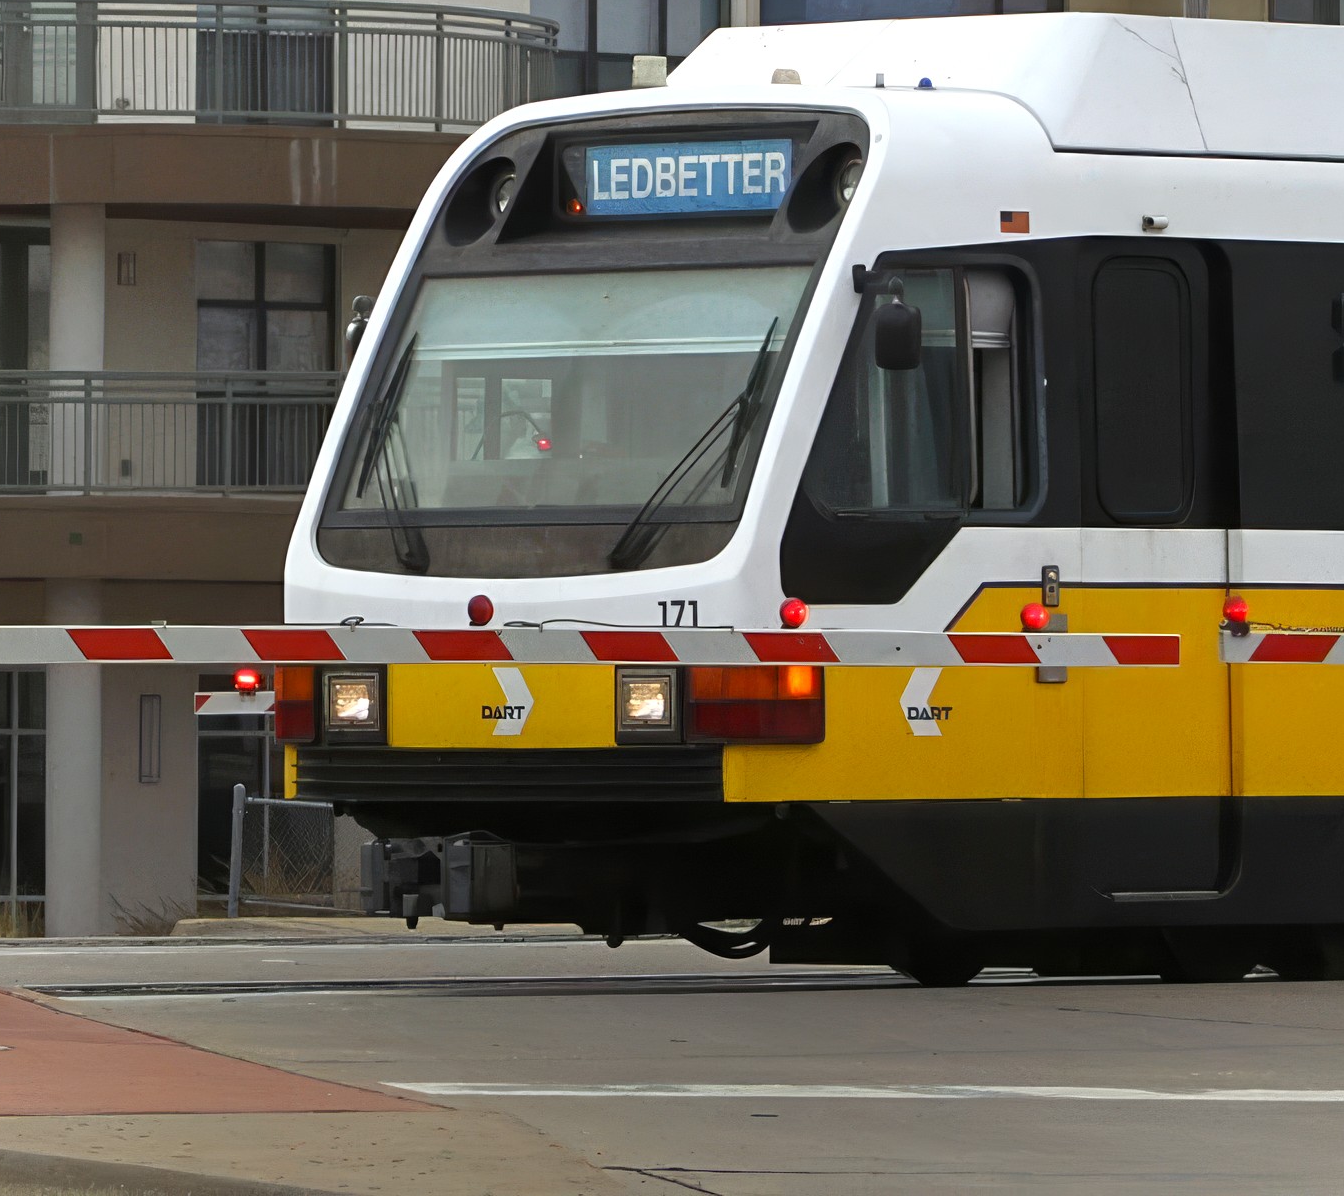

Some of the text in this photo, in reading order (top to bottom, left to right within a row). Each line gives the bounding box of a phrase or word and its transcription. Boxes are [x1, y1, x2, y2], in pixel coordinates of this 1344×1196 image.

[593, 151, 786, 201] LEDBETTER
[657, 600, 698, 627] 171
[481, 705, 525, 720] DART
[907, 706, 953, 721] DART
